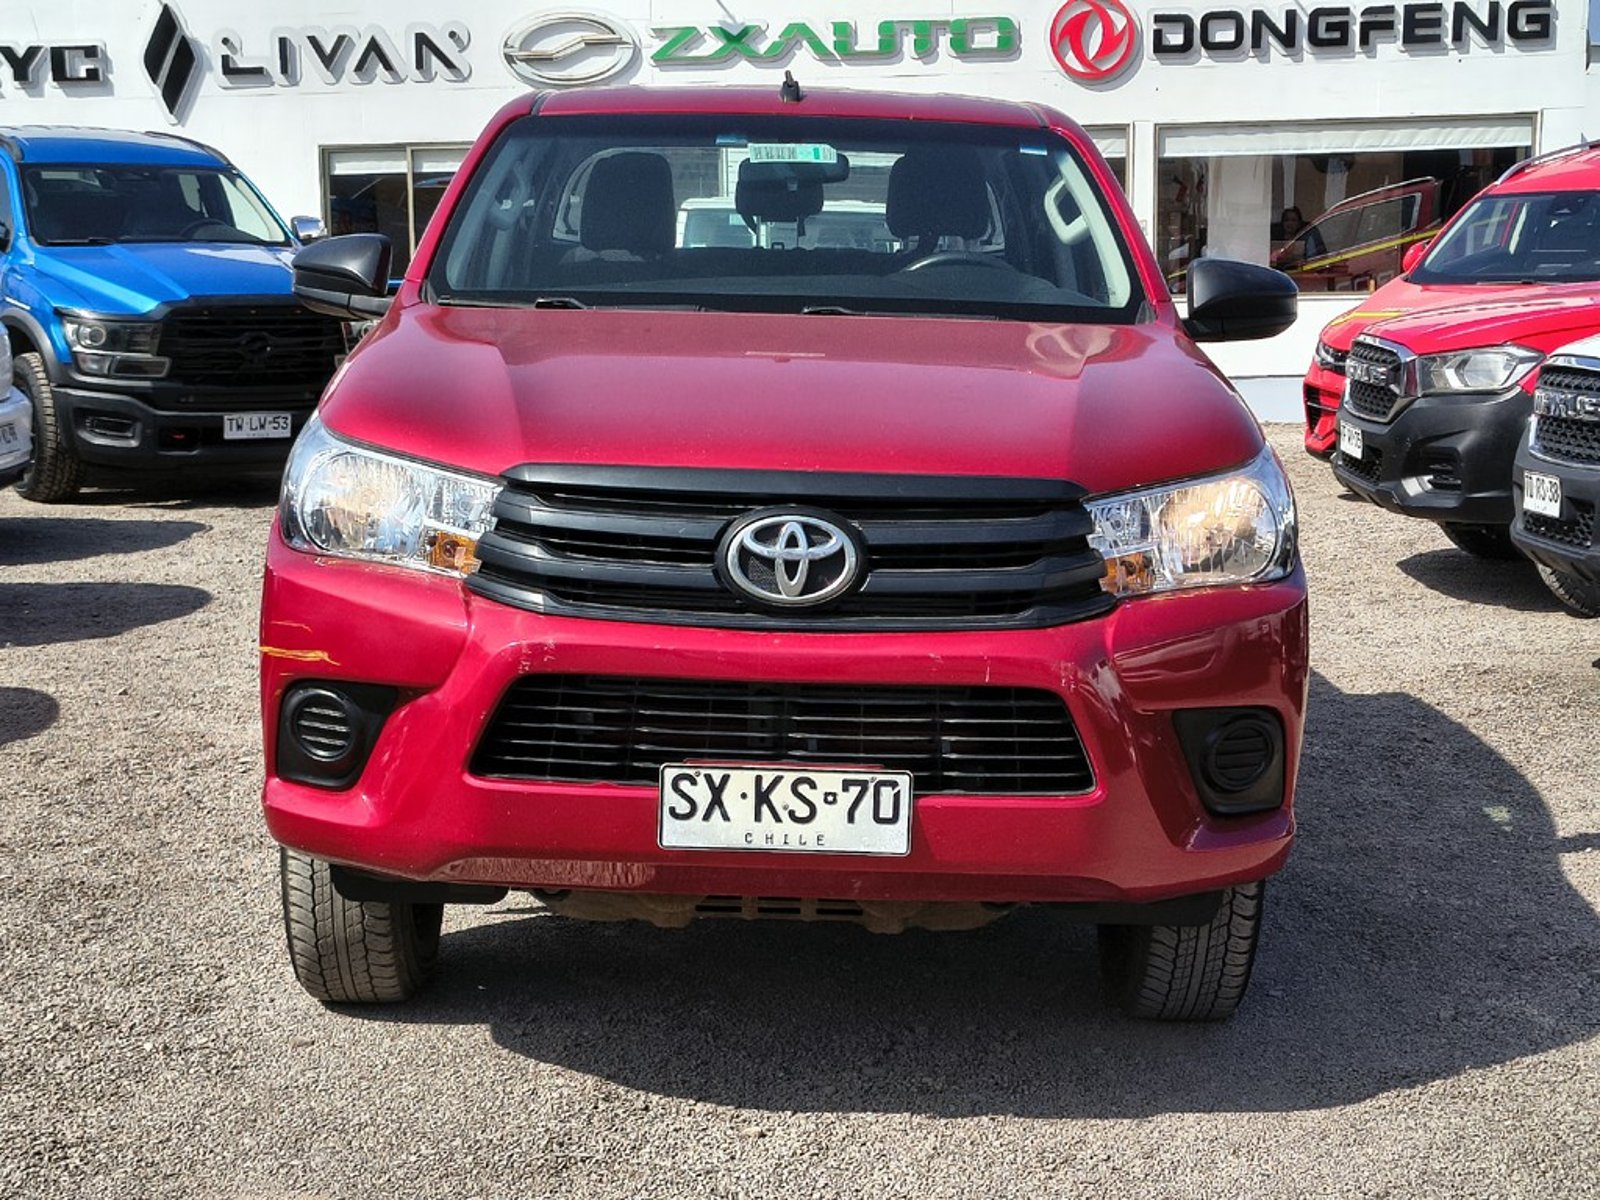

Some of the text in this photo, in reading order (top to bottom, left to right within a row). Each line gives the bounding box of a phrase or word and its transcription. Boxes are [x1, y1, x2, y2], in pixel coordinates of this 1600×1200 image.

[650, 16, 1020, 62] ZXAUTO
[1153, 0, 1552, 54] DONGFENG
[221, 30, 470, 78] LIVAN
[744, 832, 826, 846] CHILE
